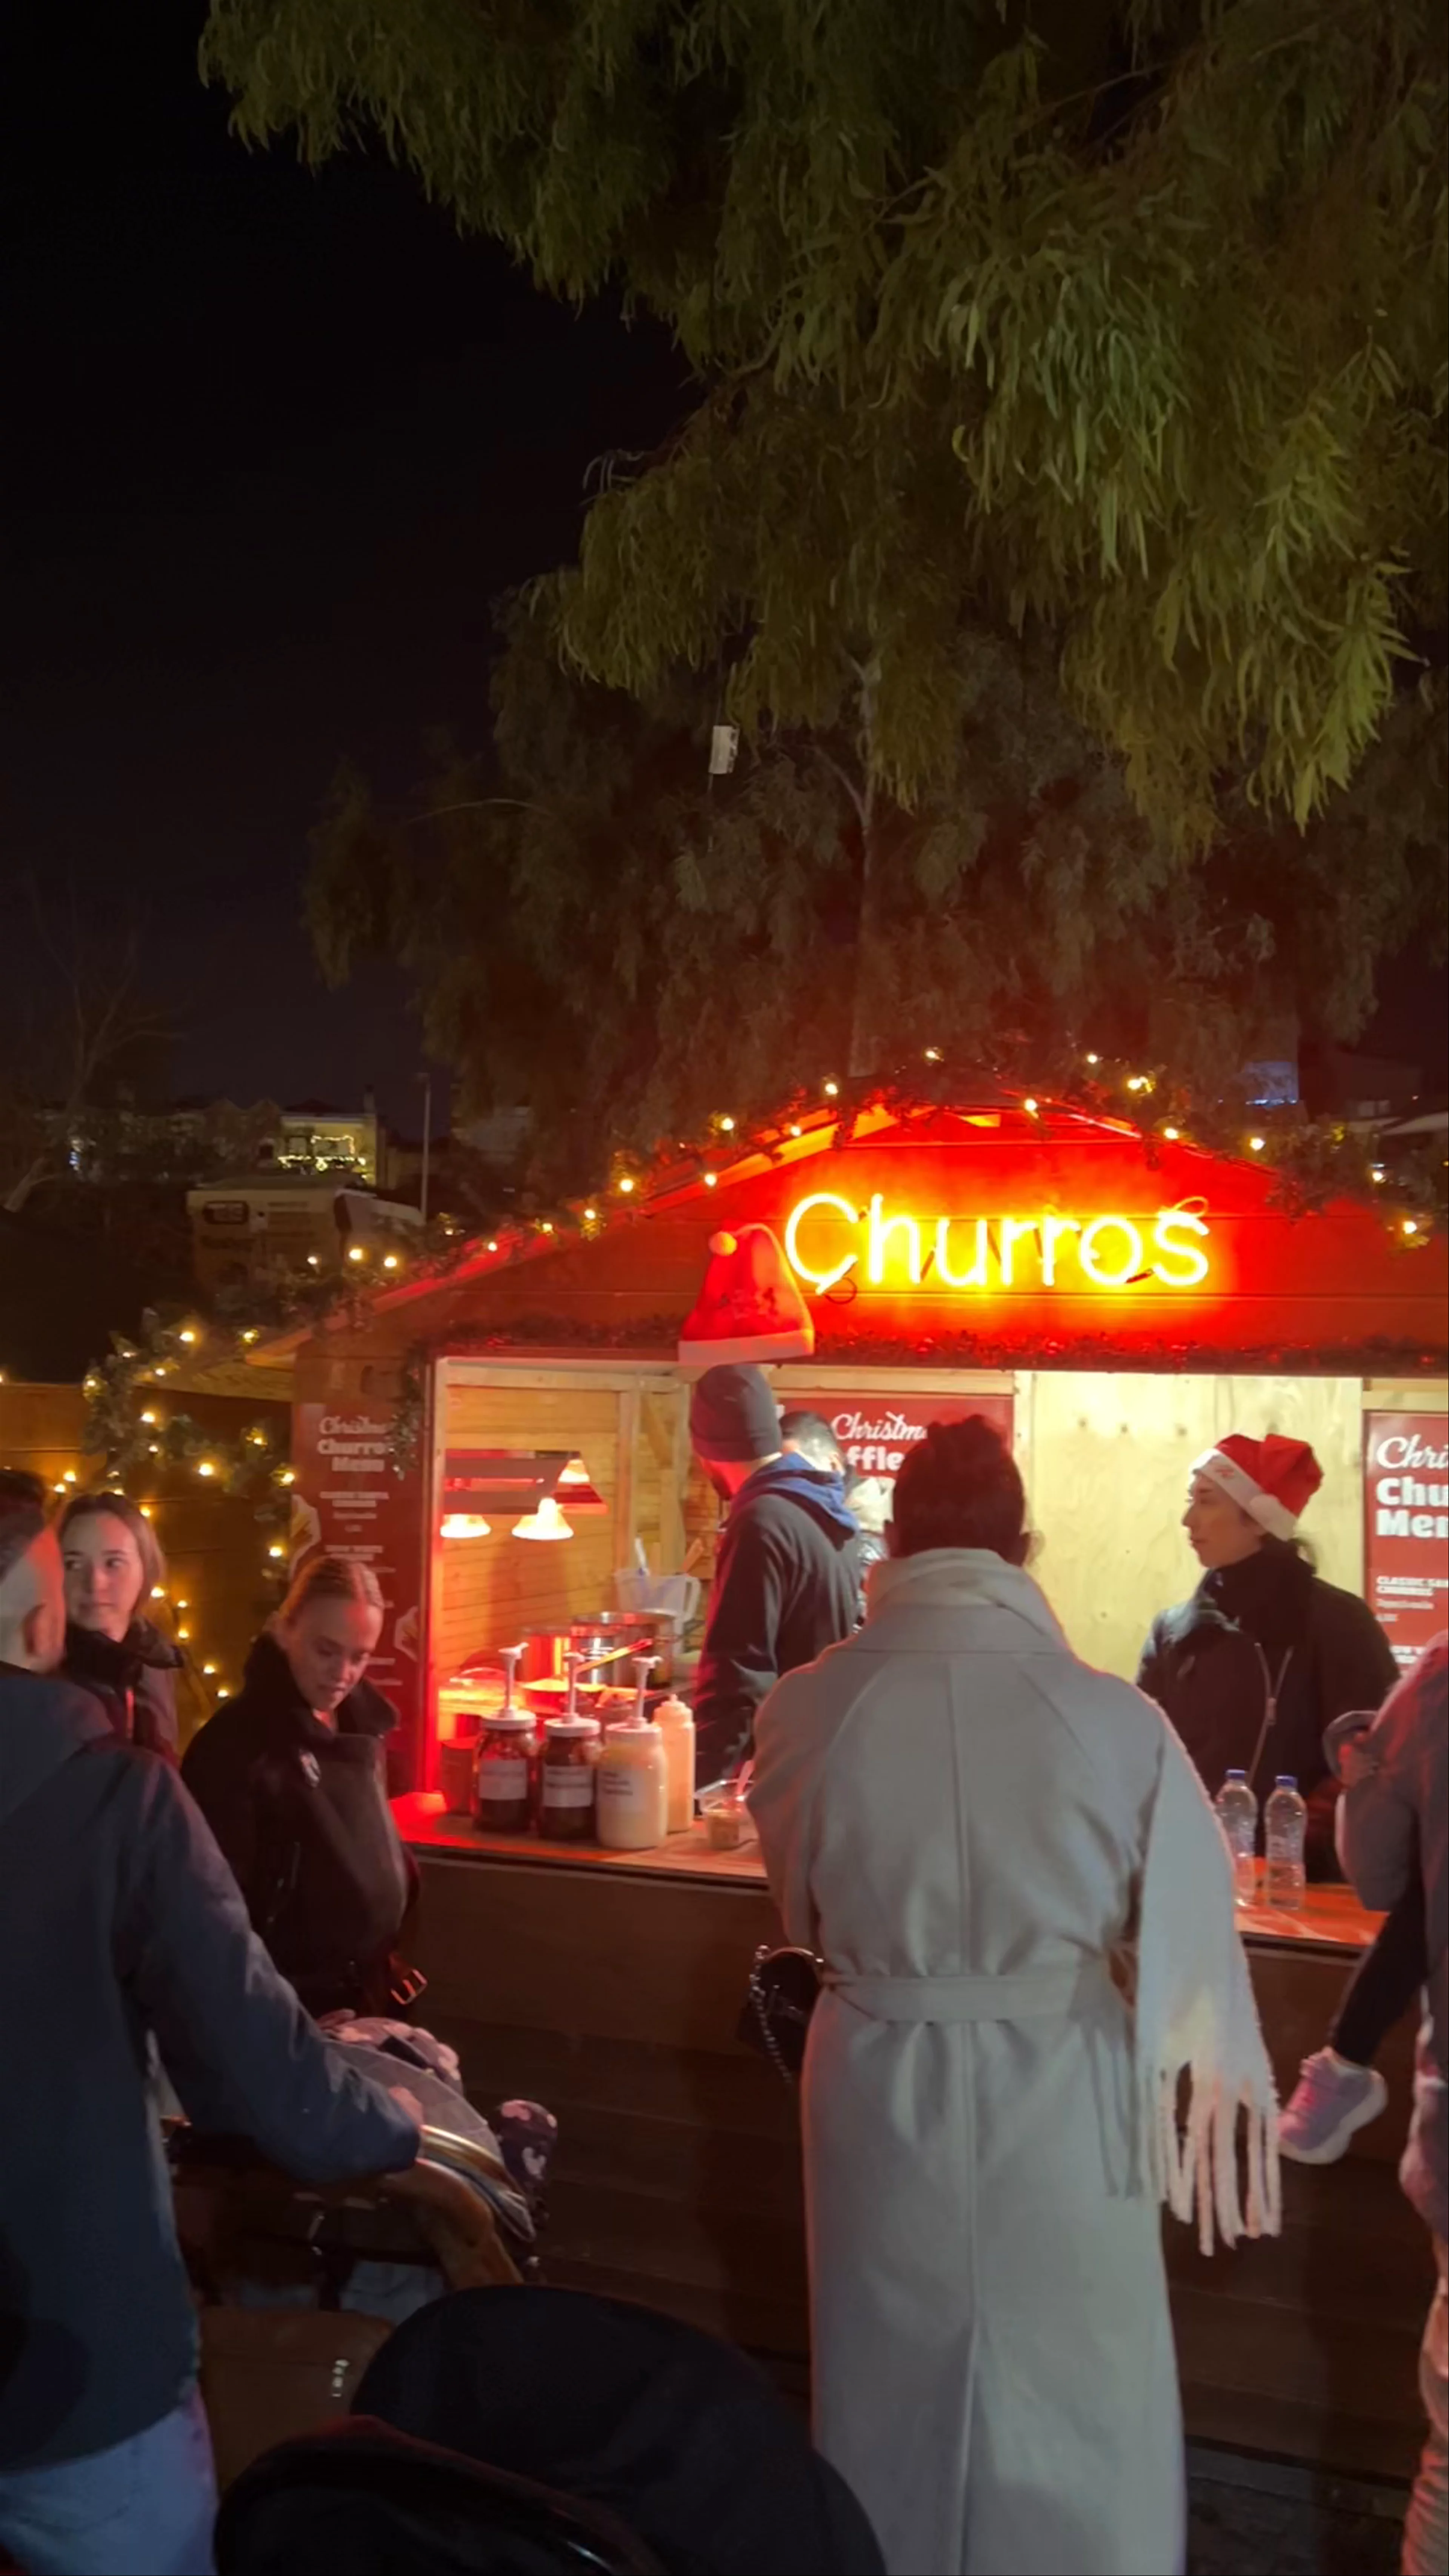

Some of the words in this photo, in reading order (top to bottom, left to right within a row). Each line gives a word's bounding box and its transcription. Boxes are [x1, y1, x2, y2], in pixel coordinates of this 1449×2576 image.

[785, 1193, 1210, 1290] Churros
[831, 1411, 928, 1440] Christm
[317, 1439, 387, 1455] Churro
